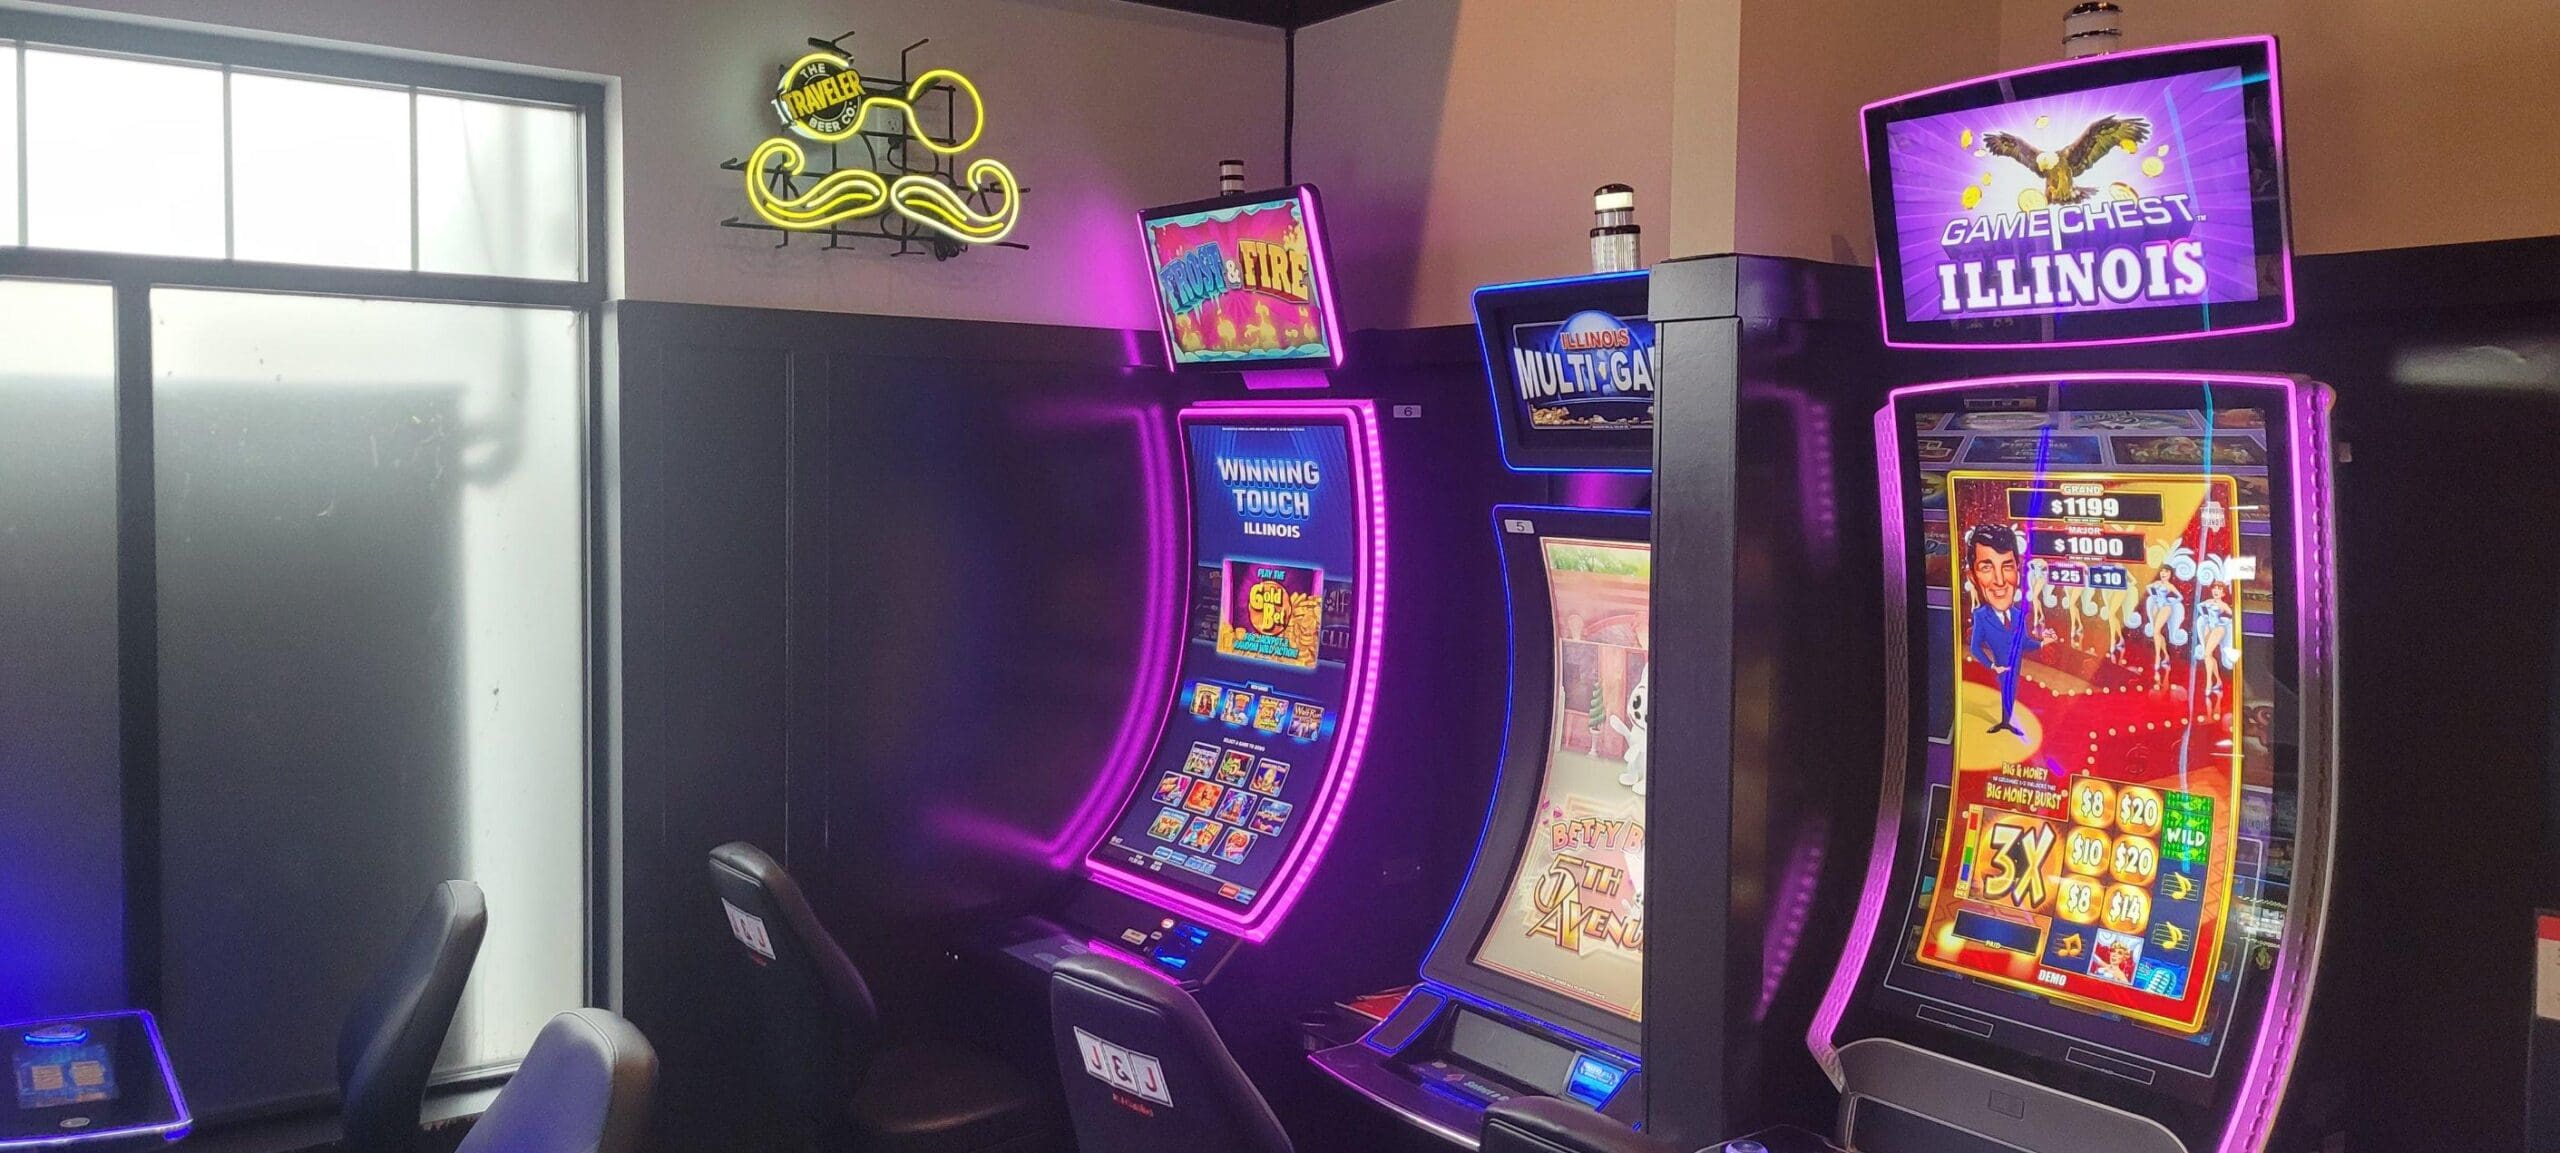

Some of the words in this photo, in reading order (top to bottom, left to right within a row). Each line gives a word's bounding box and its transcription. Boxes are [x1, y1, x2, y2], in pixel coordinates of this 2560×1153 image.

[800, 63, 826, 78] THE
[781, 70, 866, 119] TRAVELER
[809, 117, 841, 133] BEER
[1940, 208, 2050, 246] GAME
[2057, 194, 2195, 233] CHEST
[1159, 241, 1228, 313] FROST
[1226, 260, 1241, 284] &
[1238, 239, 1310, 304] FIRE
[1938, 239, 2209, 312] ILLINOIS
[1560, 328, 1630, 350] ILLINOIS
[1514, 347, 1598, 400] MULTI
[1403, 406, 1413, 417] 6
[1217, 457, 1320, 488] WINNING
[1232, 489, 1310, 518] TOUCH
[2063, 485, 2101, 494] GRAND
[2051, 497, 2119, 517] $1199
[1243, 522, 1301, 538] ILLINOIS
[1516, 522, 1525, 532] 5
[2068, 525, 2101, 535] MAJOR
[2054, 537, 2124, 556] $1000
[1257, 568, 1272, 579] PLAY
[2051, 569, 2081, 583] $25
[2094, 572, 2122, 586] $10
[1249, 583, 1283, 611] Gold
[1262, 604, 1286, 631] Bet
[2002, 760, 2015, 776] BIG
[2023, 766, 2049, 781] MONEY
[1986, 782, 2002, 800] BIG
[2002, 786, 2034, 805] MONEY
[2034, 790, 2062, 810] BURST
[2081, 785, 2105, 819] $8
[2119, 791, 2159, 829] $20
[1552, 818, 1625, 851] BETTY
[2167, 828, 2206, 847] WILD
[1984, 821, 2057, 909] 3X
[2072, 836, 2102, 867] $10
[2114, 841, 2154, 878] $20
[1534, 853, 1624, 914] 5TH
[2068, 882, 2092, 915] $8
[2109, 890, 2142, 926] $14
[1985, 940, 2001, 949] PAID
[2038, 969, 2067, 986] DEMO
[1091, 1045, 1158, 1093] J&J
